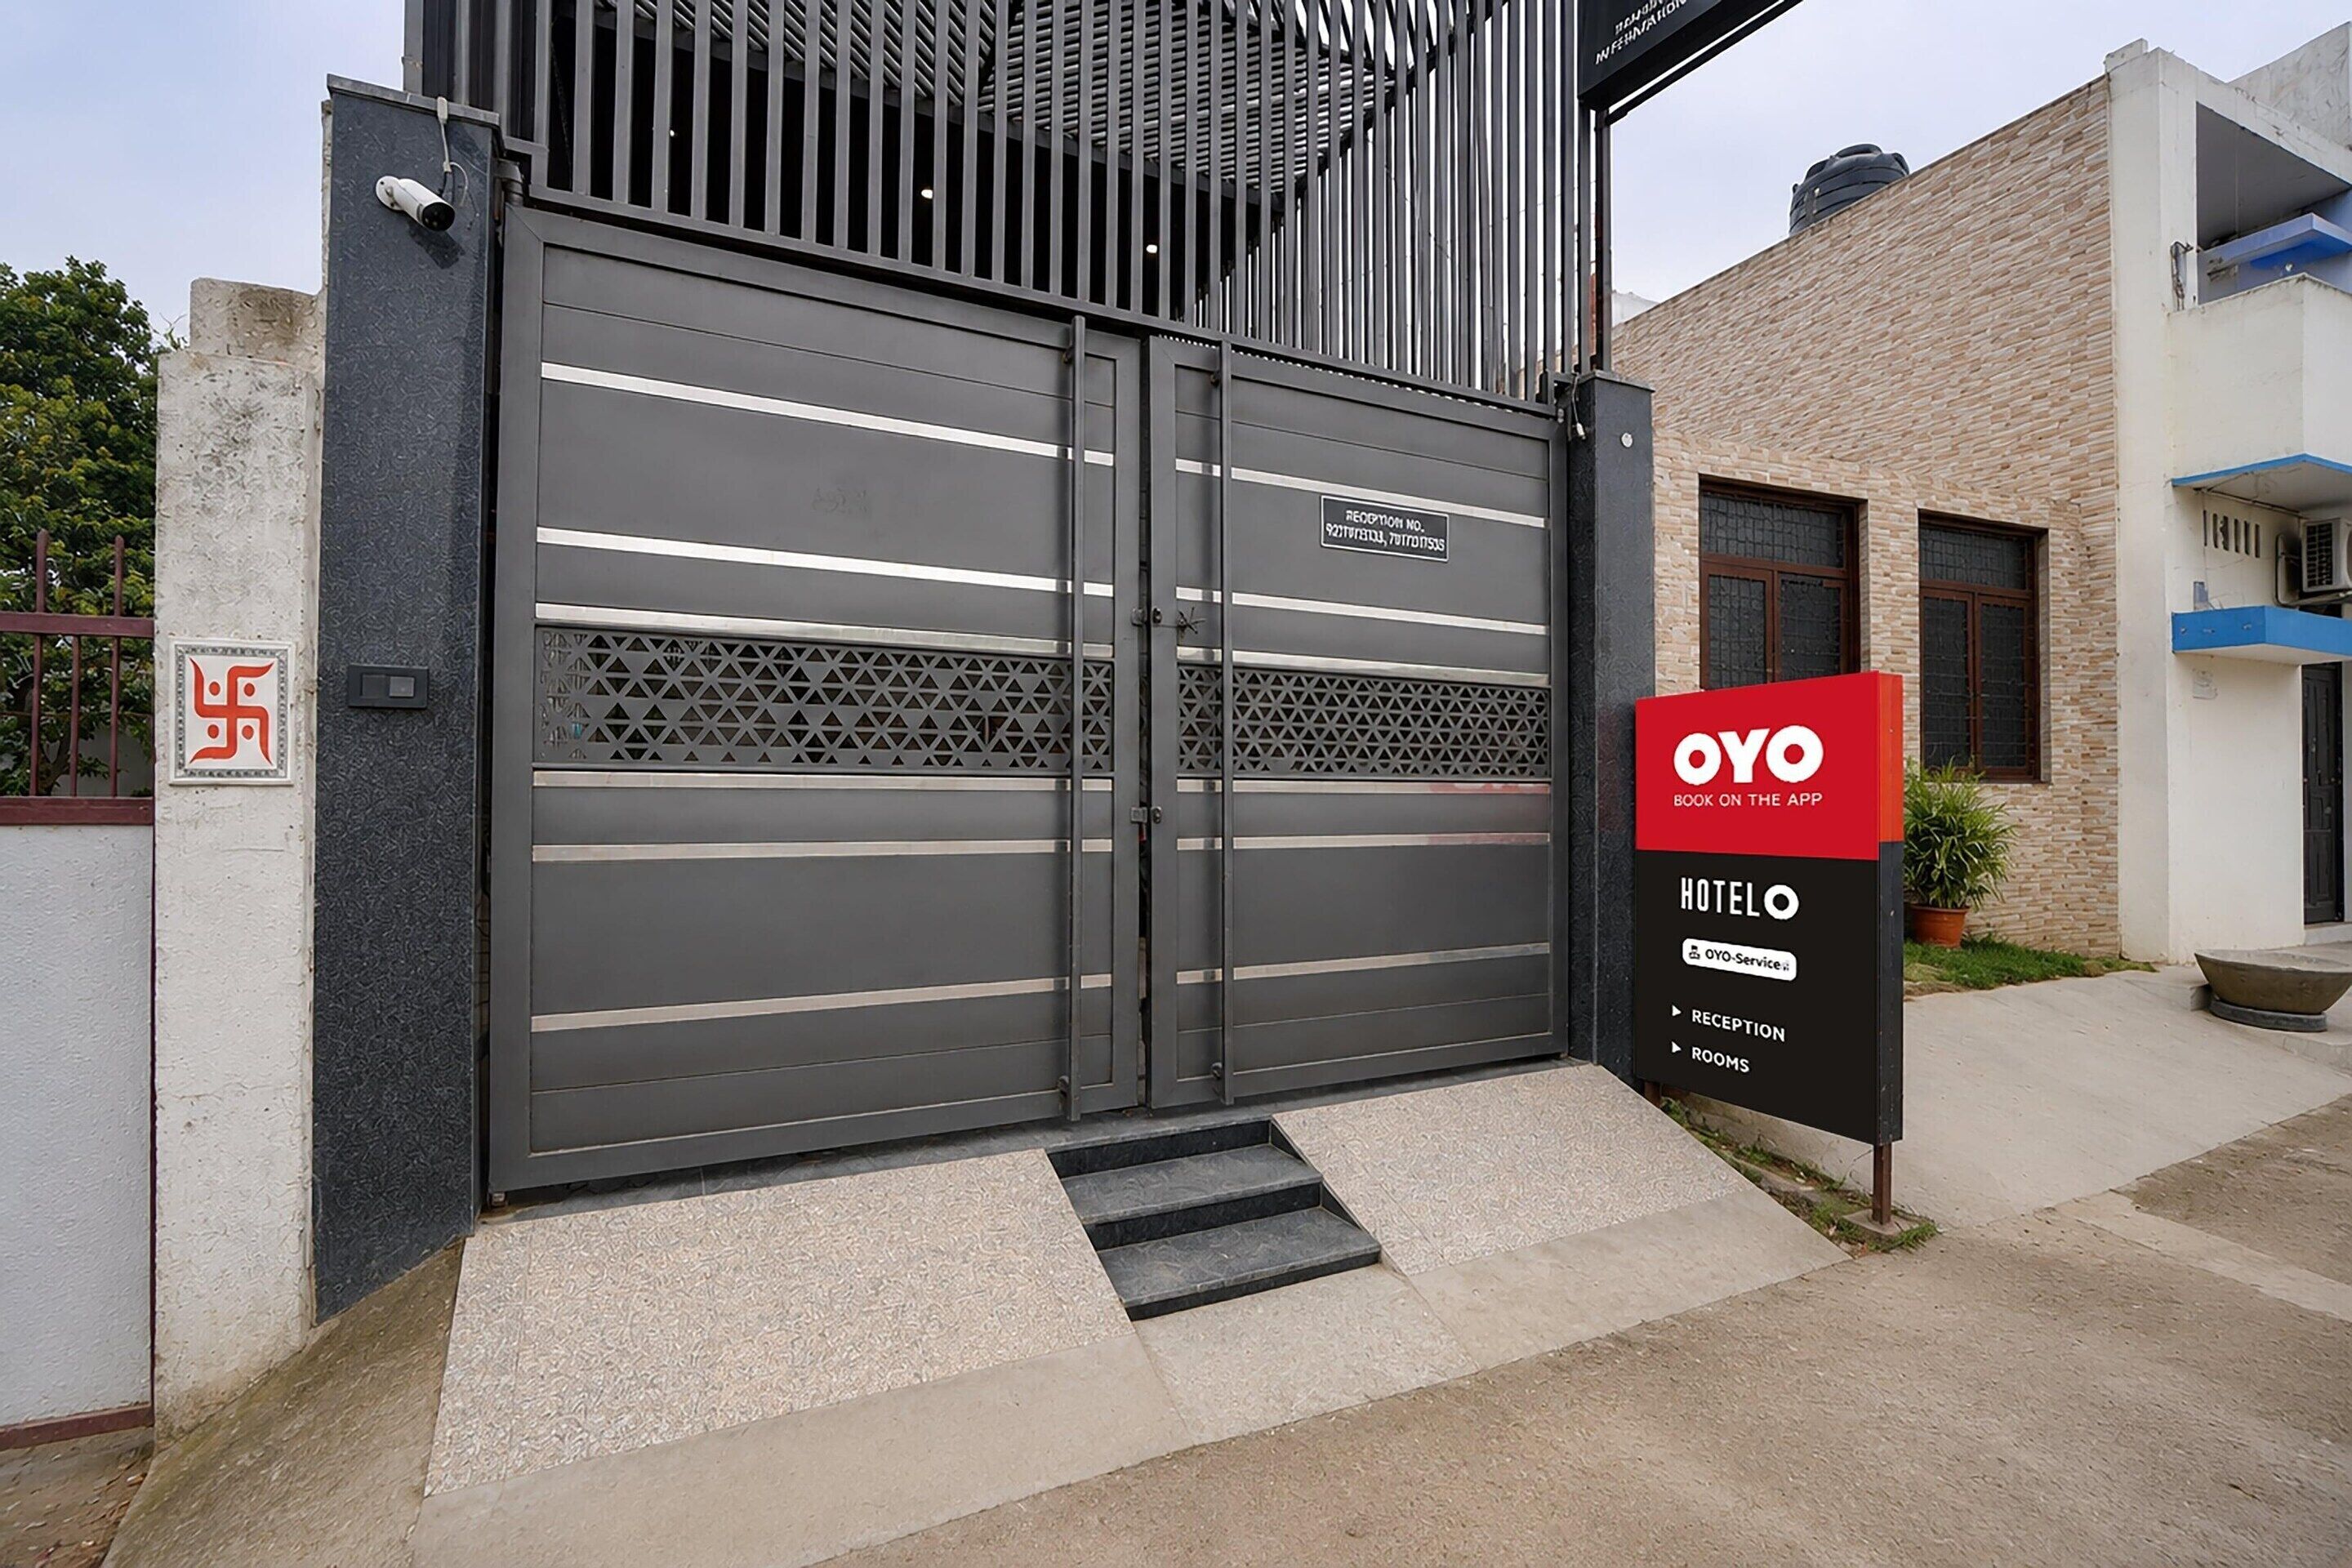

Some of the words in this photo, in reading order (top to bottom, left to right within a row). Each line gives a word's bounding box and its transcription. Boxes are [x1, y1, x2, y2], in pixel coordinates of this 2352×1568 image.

[1406, 518, 1425, 532] NO.
[1673, 725, 1824, 786] OYO
[1673, 794, 1713, 807] BOOK
[1719, 794, 1741, 807] ON
[1748, 794, 1781, 806] THE
[1787, 792, 1823, 806] APP
[1681, 877, 1760, 917] HOTEL
[1692, 1009, 1785, 1042] RECEPTION
[1692, 1046, 1750, 1073] ROOMS
